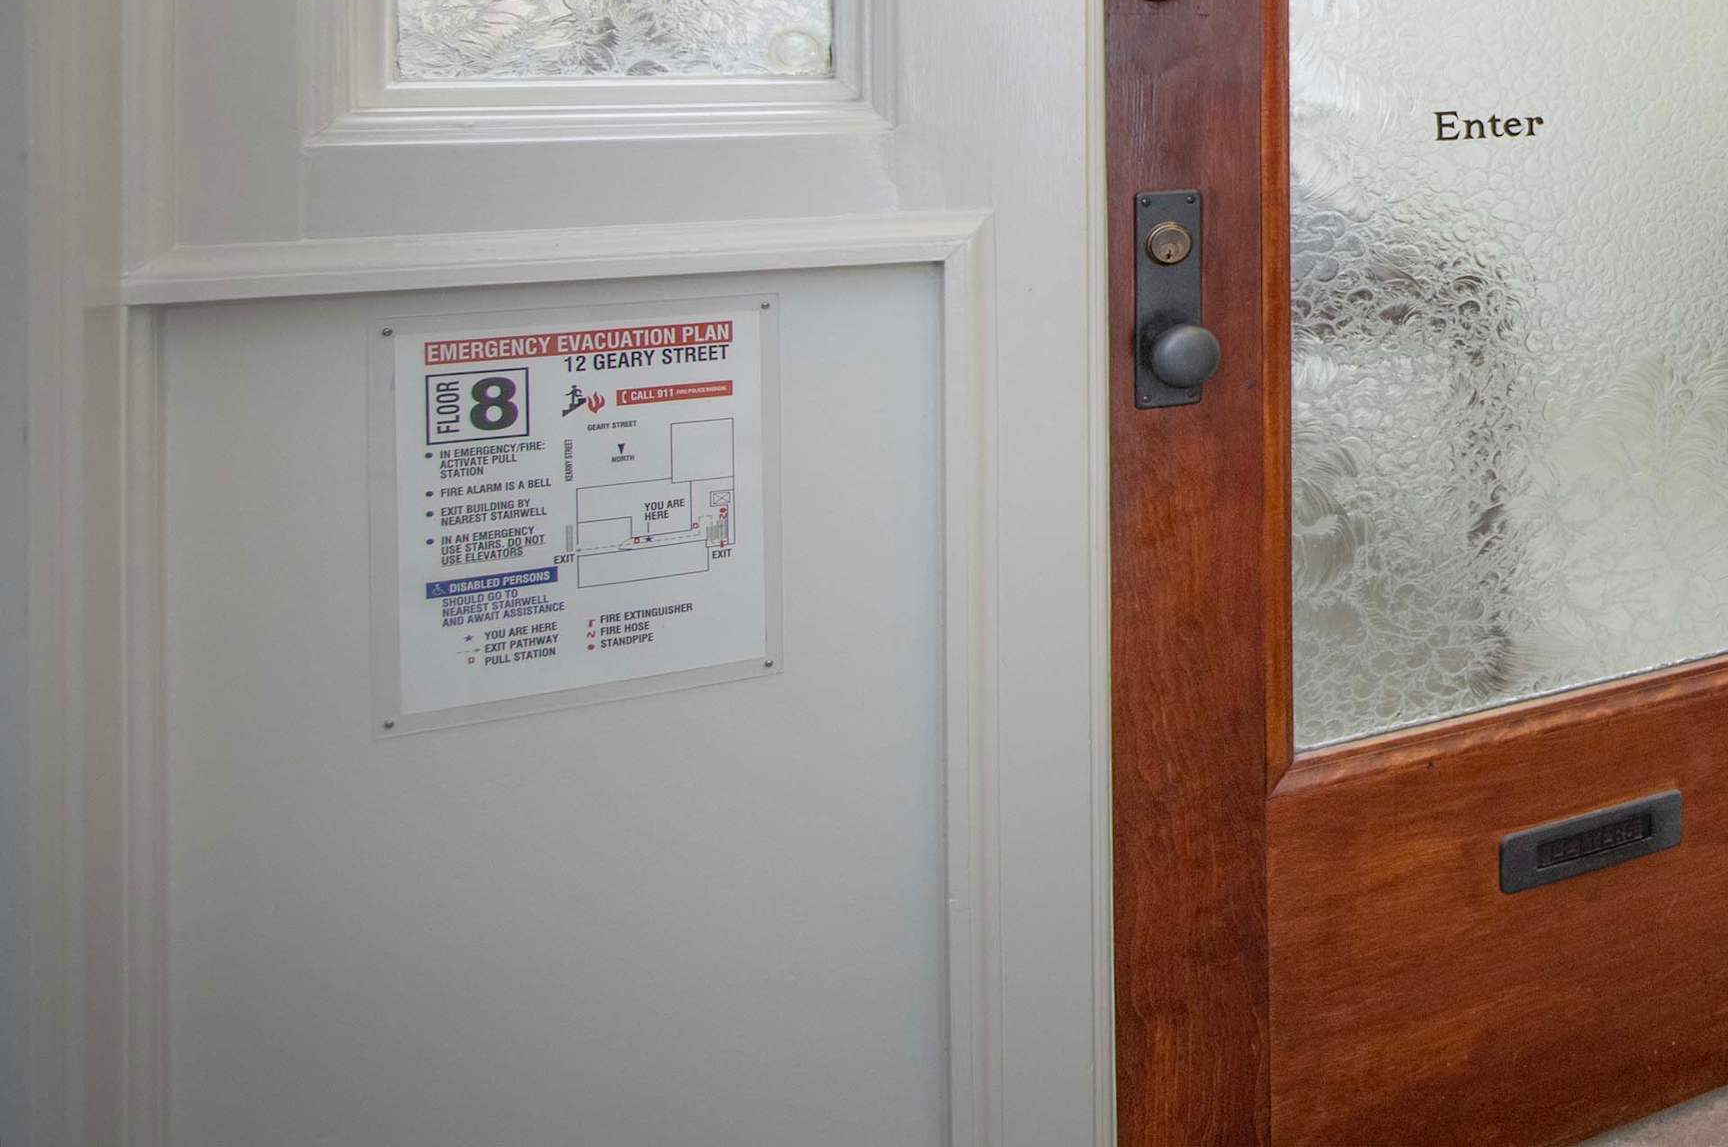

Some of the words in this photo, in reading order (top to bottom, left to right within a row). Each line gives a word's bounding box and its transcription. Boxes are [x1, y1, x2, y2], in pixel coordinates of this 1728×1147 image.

[1433, 111, 1544, 141] Enter
[427, 336, 551, 363] EMERGENCY
[557, 328, 675, 353] EVACUATION
[682, 324, 729, 343] PLAN
[563, 355, 587, 373] 12
[593, 350, 655, 370] GEARY
[662, 344, 729, 365] STREET
[470, 377, 519, 431] 8
[631, 389, 655, 401] CALL
[657, 388, 674, 399] 911
[436, 381, 460, 434] FLOOR
[587, 423, 611, 431] GEARY
[612, 420, 637, 429] STREET
[440, 450, 450, 459] IN
[454, 441, 545, 458] EMERGENCY/FIRE:
[611, 454, 635, 463] NORTH
[440, 456, 489, 469] ACTIVATE
[491, 454, 518, 464] PULL
[440, 467, 485, 479] STATION
[440, 486, 464, 497] FIRE
[466, 483, 502, 495] ALARM
[505, 481, 515, 491] IS
[518, 480, 525, 490] A
[527, 478, 552, 489] BELL
[441, 506, 464, 517] EXIT
[466, 500, 515, 514] BUILDING
[517, 498, 531, 508] BY
[644, 502, 664, 512] YOU
[666, 498, 685, 509] ARE
[441, 513, 488, 527] NEAREST
[490, 507, 548, 521] STAIRWELL
[644, 510, 669, 521] HERE
[441, 535, 452, 545] IN
[455, 533, 469, 543] AN
[472, 526, 535, 542] EMERGENCY
[441, 545, 465, 556] USE
[507, 538, 522, 548] DO
[524, 534, 545, 546] NOT
[441, 555, 464, 566] USE
[465, 547, 524, 562] ELEVATORS
[554, 553, 576, 565] EXIT
[712, 548, 732, 560] EXIT
[449, 578, 500, 594] DISABLED
[502, 571, 551, 585] PERSONS
[442, 594, 484, 608] SHOULD
[487, 591, 502, 602] GO
[506, 589, 518, 599] TO
[442, 603, 489, 618] NEAREST
[492, 595, 549, 611] STAIRWELL
[442, 617, 464, 628] AND
[467, 611, 500, 624] AWAIT
[503, 602, 565, 619] ASSISTANCE
[600, 612, 622, 624] FIRE
[624, 603, 694, 622] EXTINGUISHER
[484, 630, 506, 640] YOU
[508, 626, 528, 637] ARE
[531, 621, 559, 634] HERE
[600, 625, 622, 637] FIRE
[624, 621, 650, 633] HOSE
[484, 642, 507, 653] EXIT
[509, 633, 560, 650] PATHWAY
[600, 633, 654, 649] STANDPIPE
[484, 654, 511, 666] PULL
[513, 647, 556, 662] STATION
